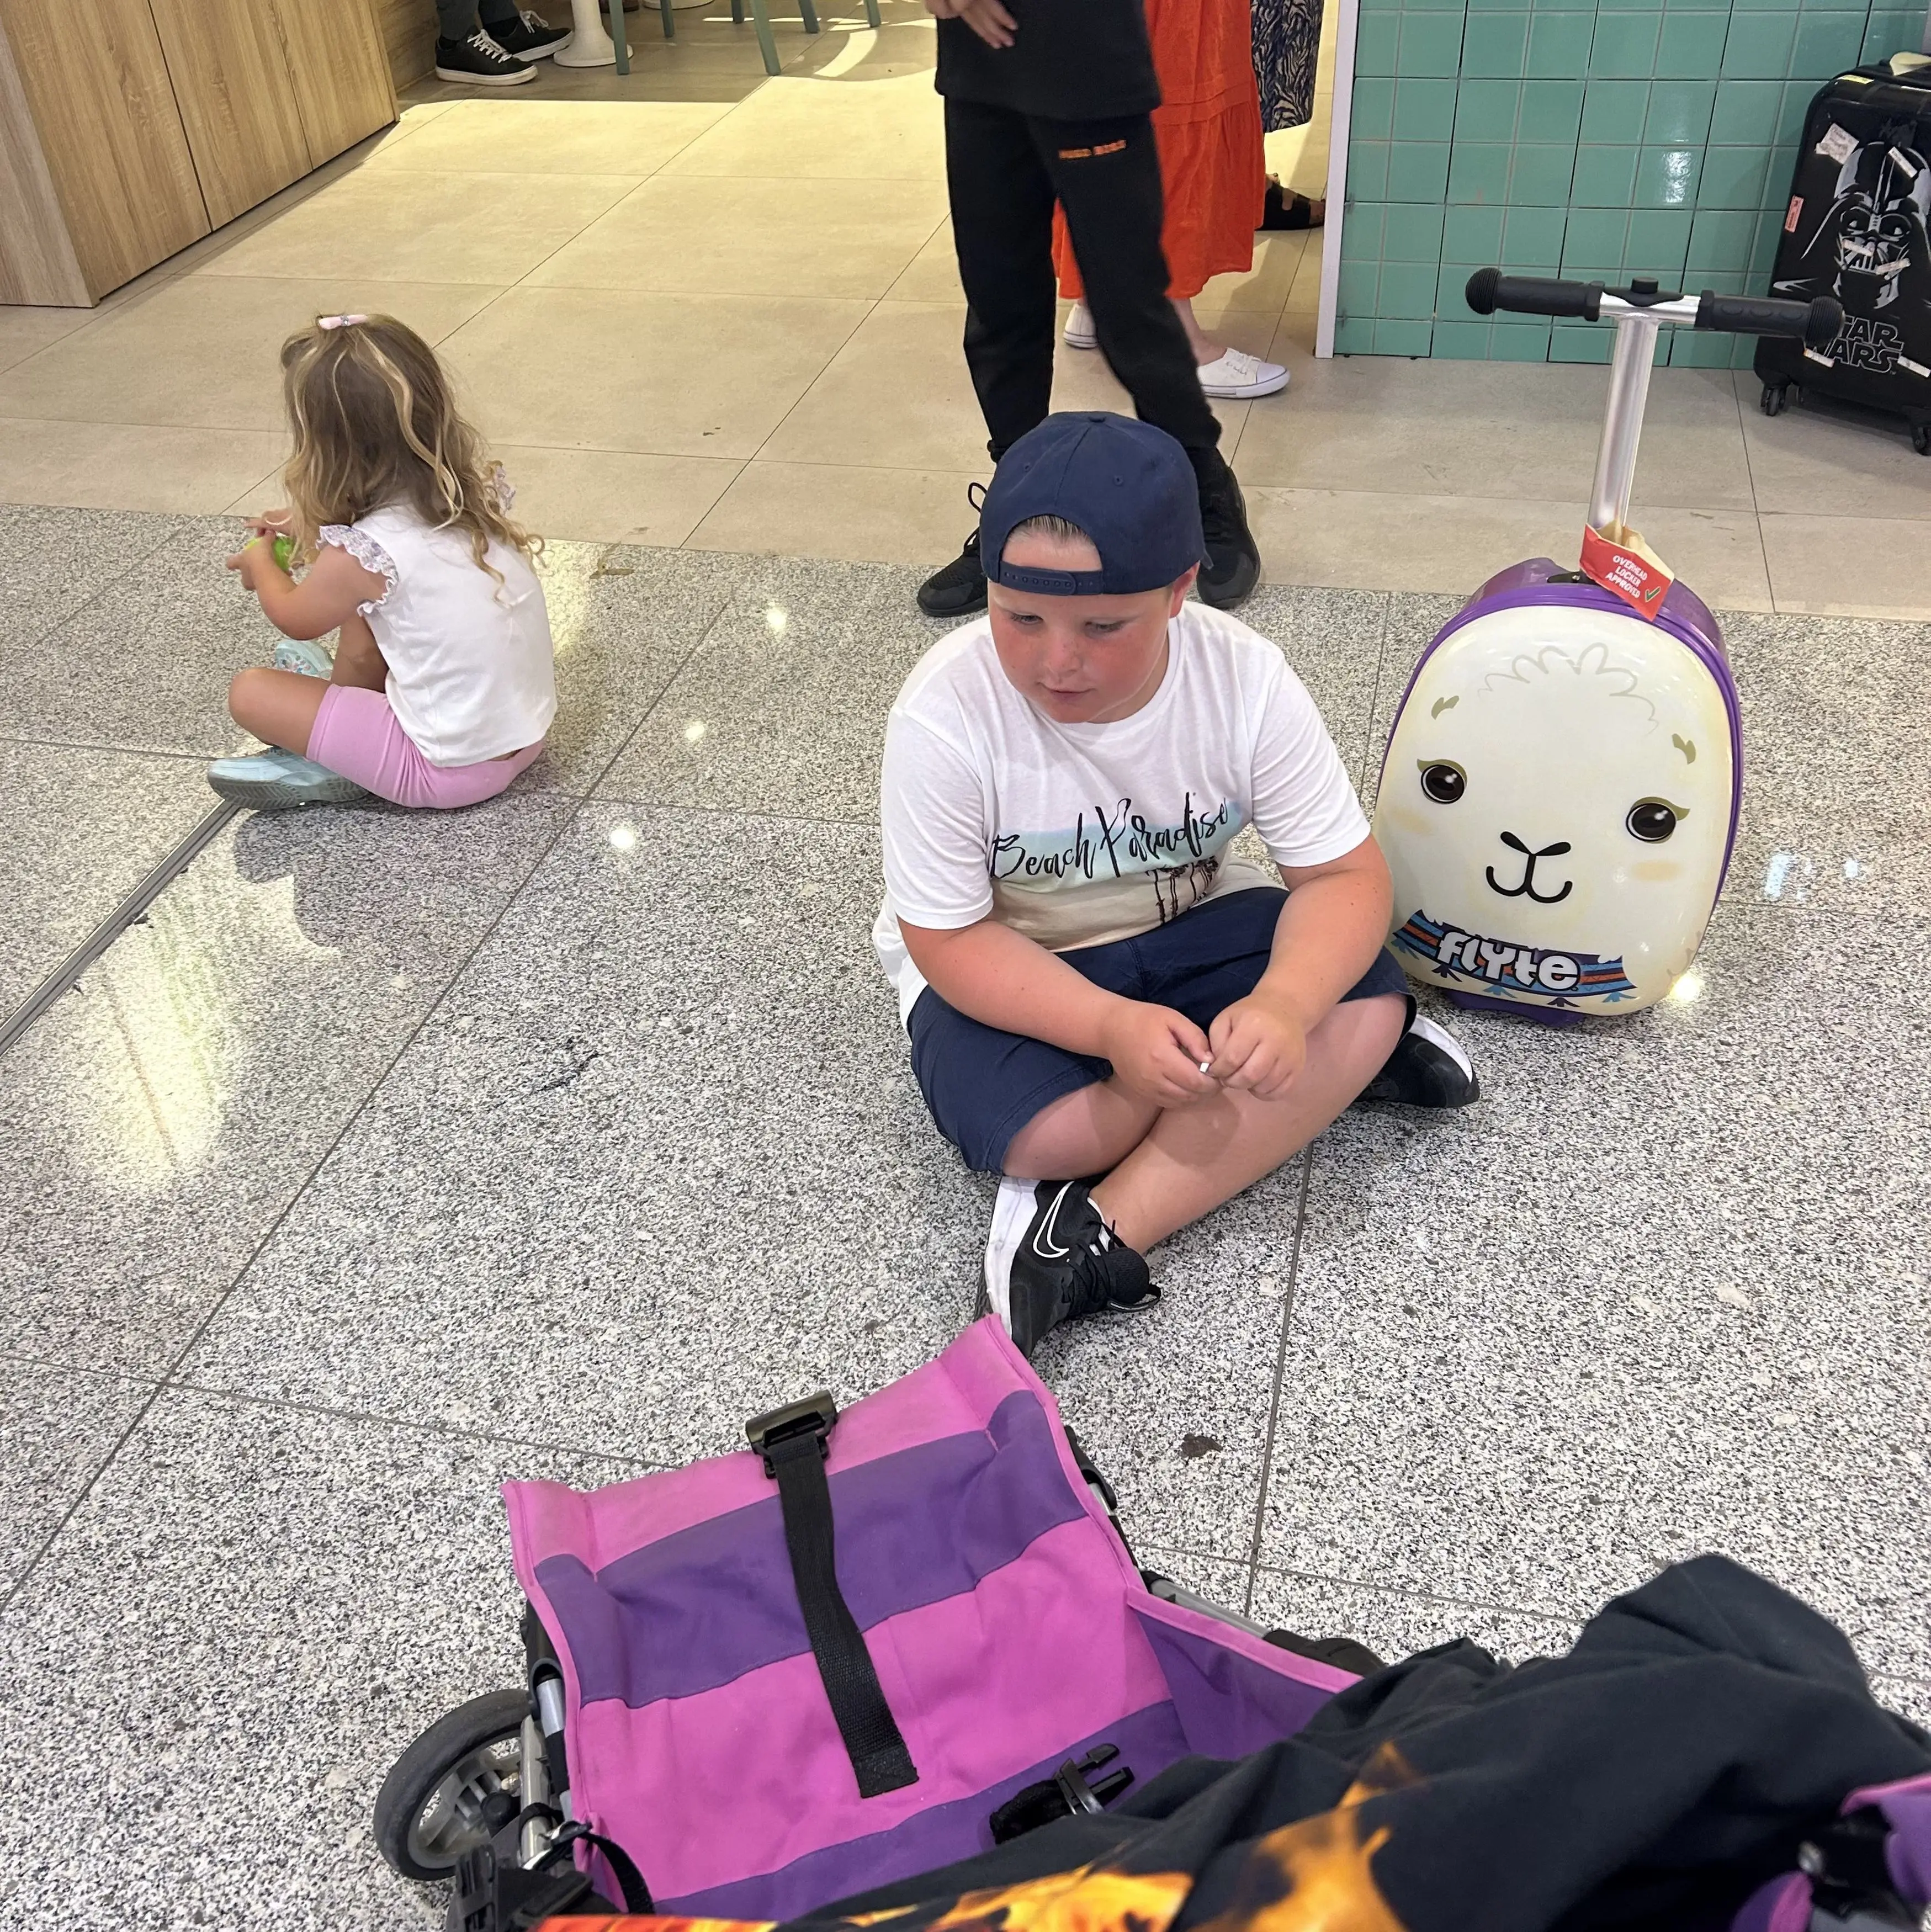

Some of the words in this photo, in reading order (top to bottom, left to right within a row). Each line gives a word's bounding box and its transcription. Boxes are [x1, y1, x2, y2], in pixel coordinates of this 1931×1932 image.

[1838, 314, 1905, 351] TAR
[1612, 555, 1648, 581] OVERHEAD
[1615, 566, 1642, 587] LOCKER
[1605, 572, 1641, 598] APPROVED
[990, 812, 1097, 879] Beach
[1095, 792, 1228, 878] Paradise
